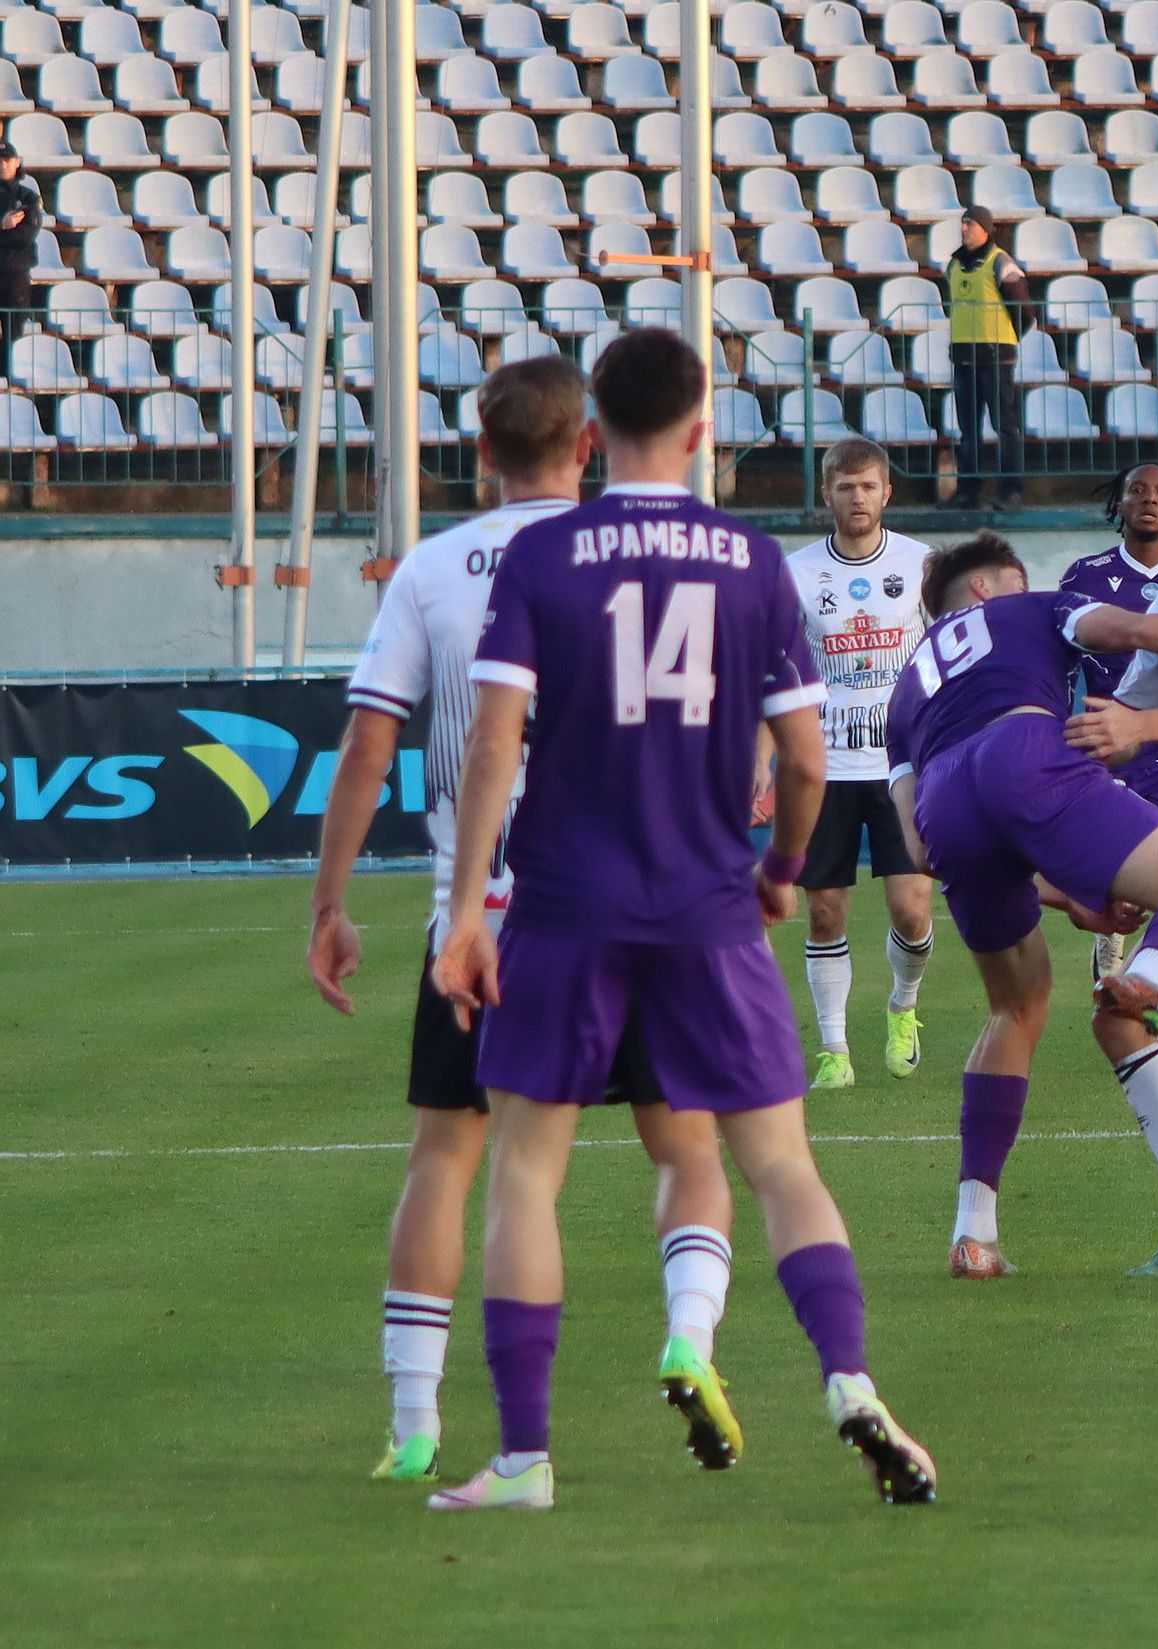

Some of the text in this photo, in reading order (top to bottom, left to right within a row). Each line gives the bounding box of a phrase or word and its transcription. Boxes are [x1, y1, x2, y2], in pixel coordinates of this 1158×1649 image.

[572, 519, 750, 569] ДРАМБАЄВ
[606, 581, 717, 727] 14
[824, 631, 901, 653] ПОЛТАВА
[909, 607, 993, 699] 19
[0, 755, 166, 821] VS
